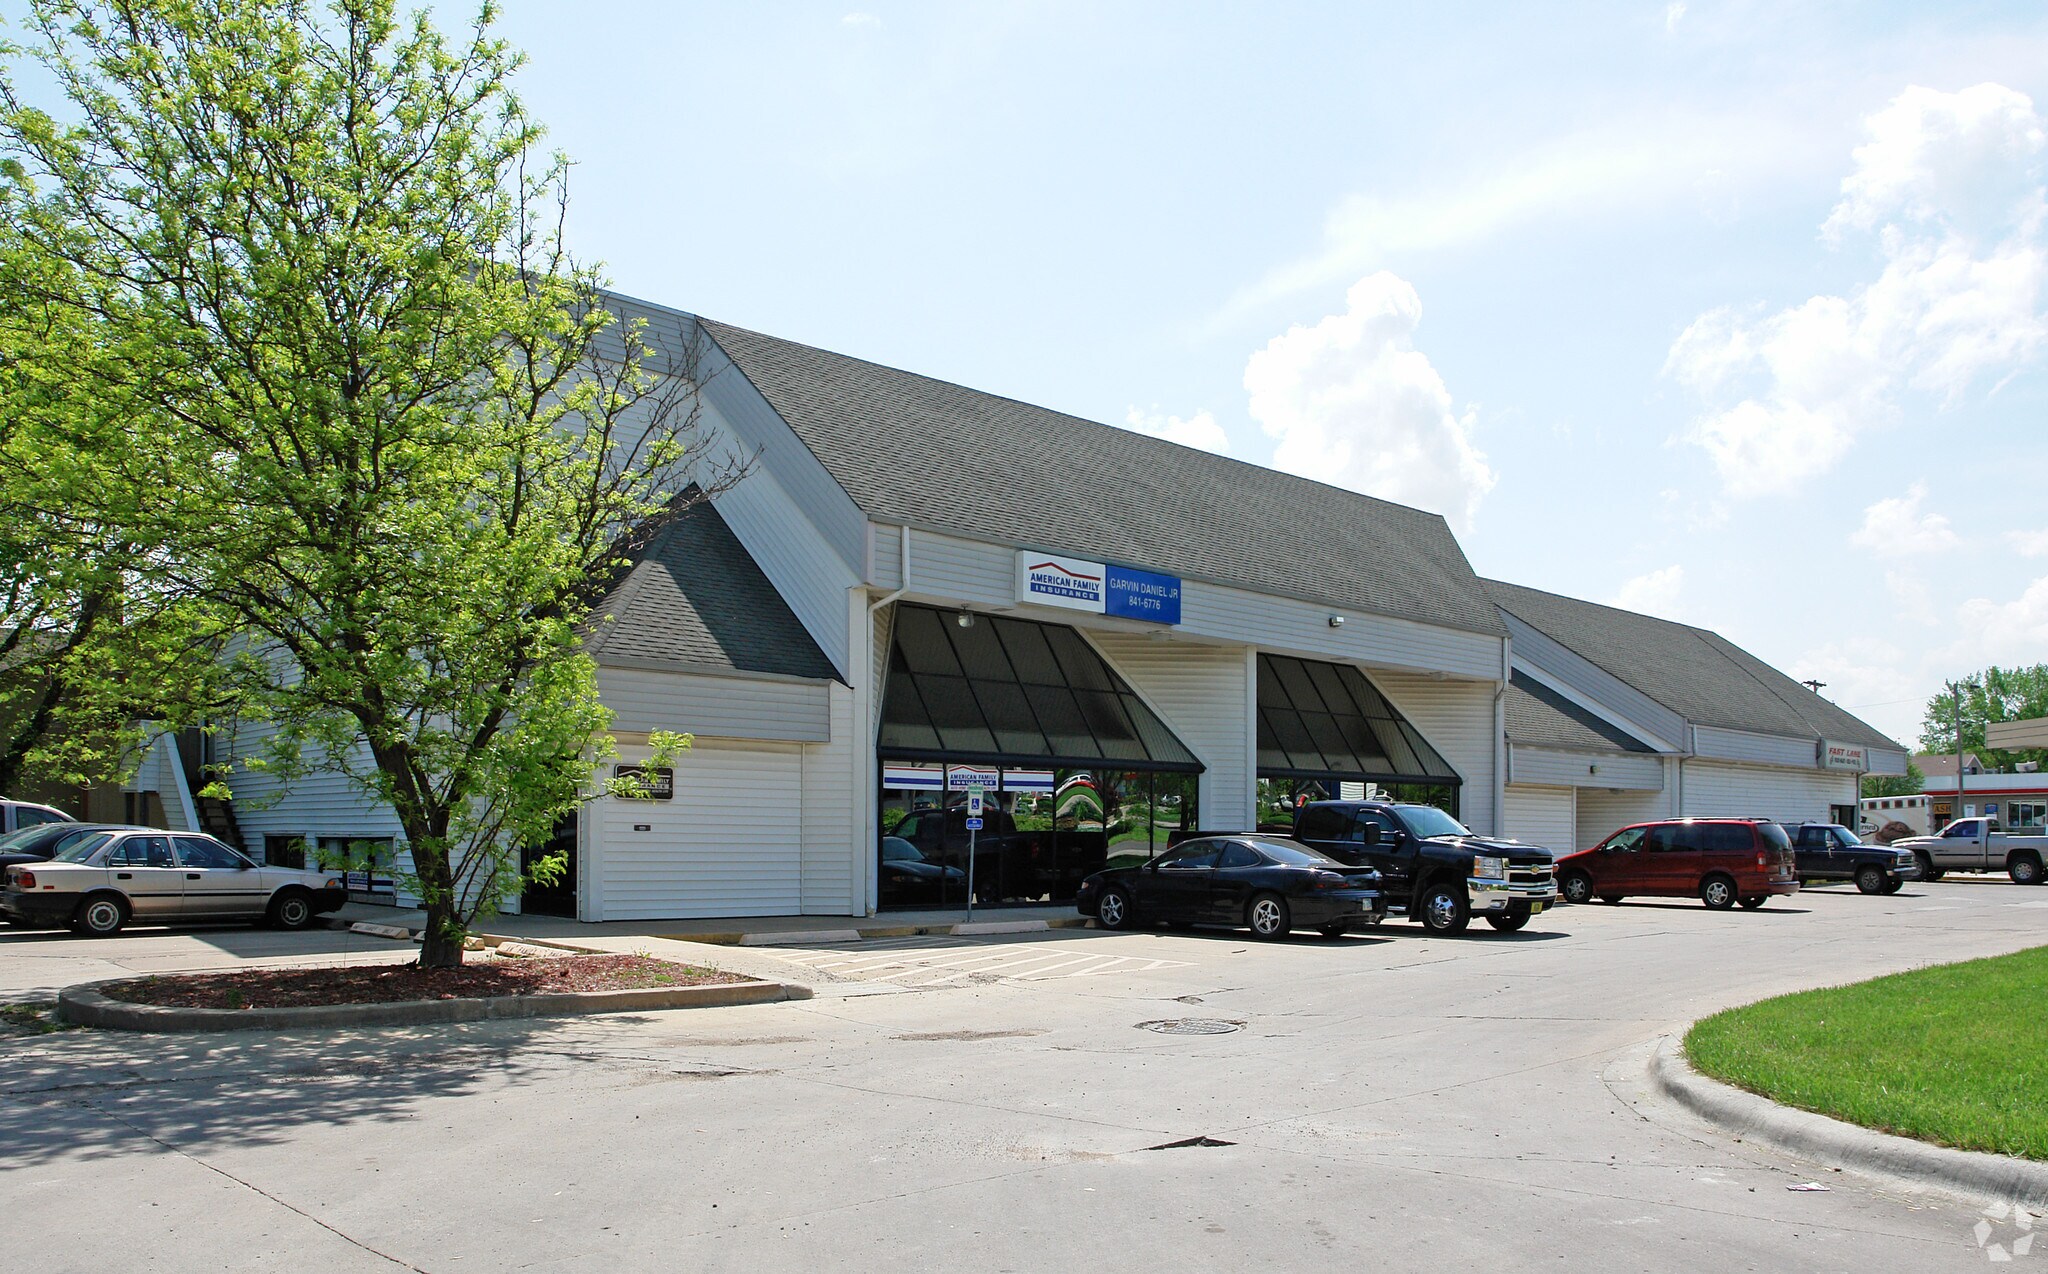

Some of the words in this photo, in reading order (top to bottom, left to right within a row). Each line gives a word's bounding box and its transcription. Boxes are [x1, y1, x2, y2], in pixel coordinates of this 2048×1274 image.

[1030, 573, 1071, 587] AMERICAN
[1073, 579, 1100, 591] FAMILY
[1110, 577, 1139, 592] GARVIN
[1140, 582, 1168, 597] DANIEL
[1168, 588, 1178, 599] JR
[1035, 584, 1095, 600] INSURANCE
[1128, 596, 1161, 610] 841-6776
[1828, 747, 1845, 756] FAST
[1934, 803, 1951, 812] ASH
